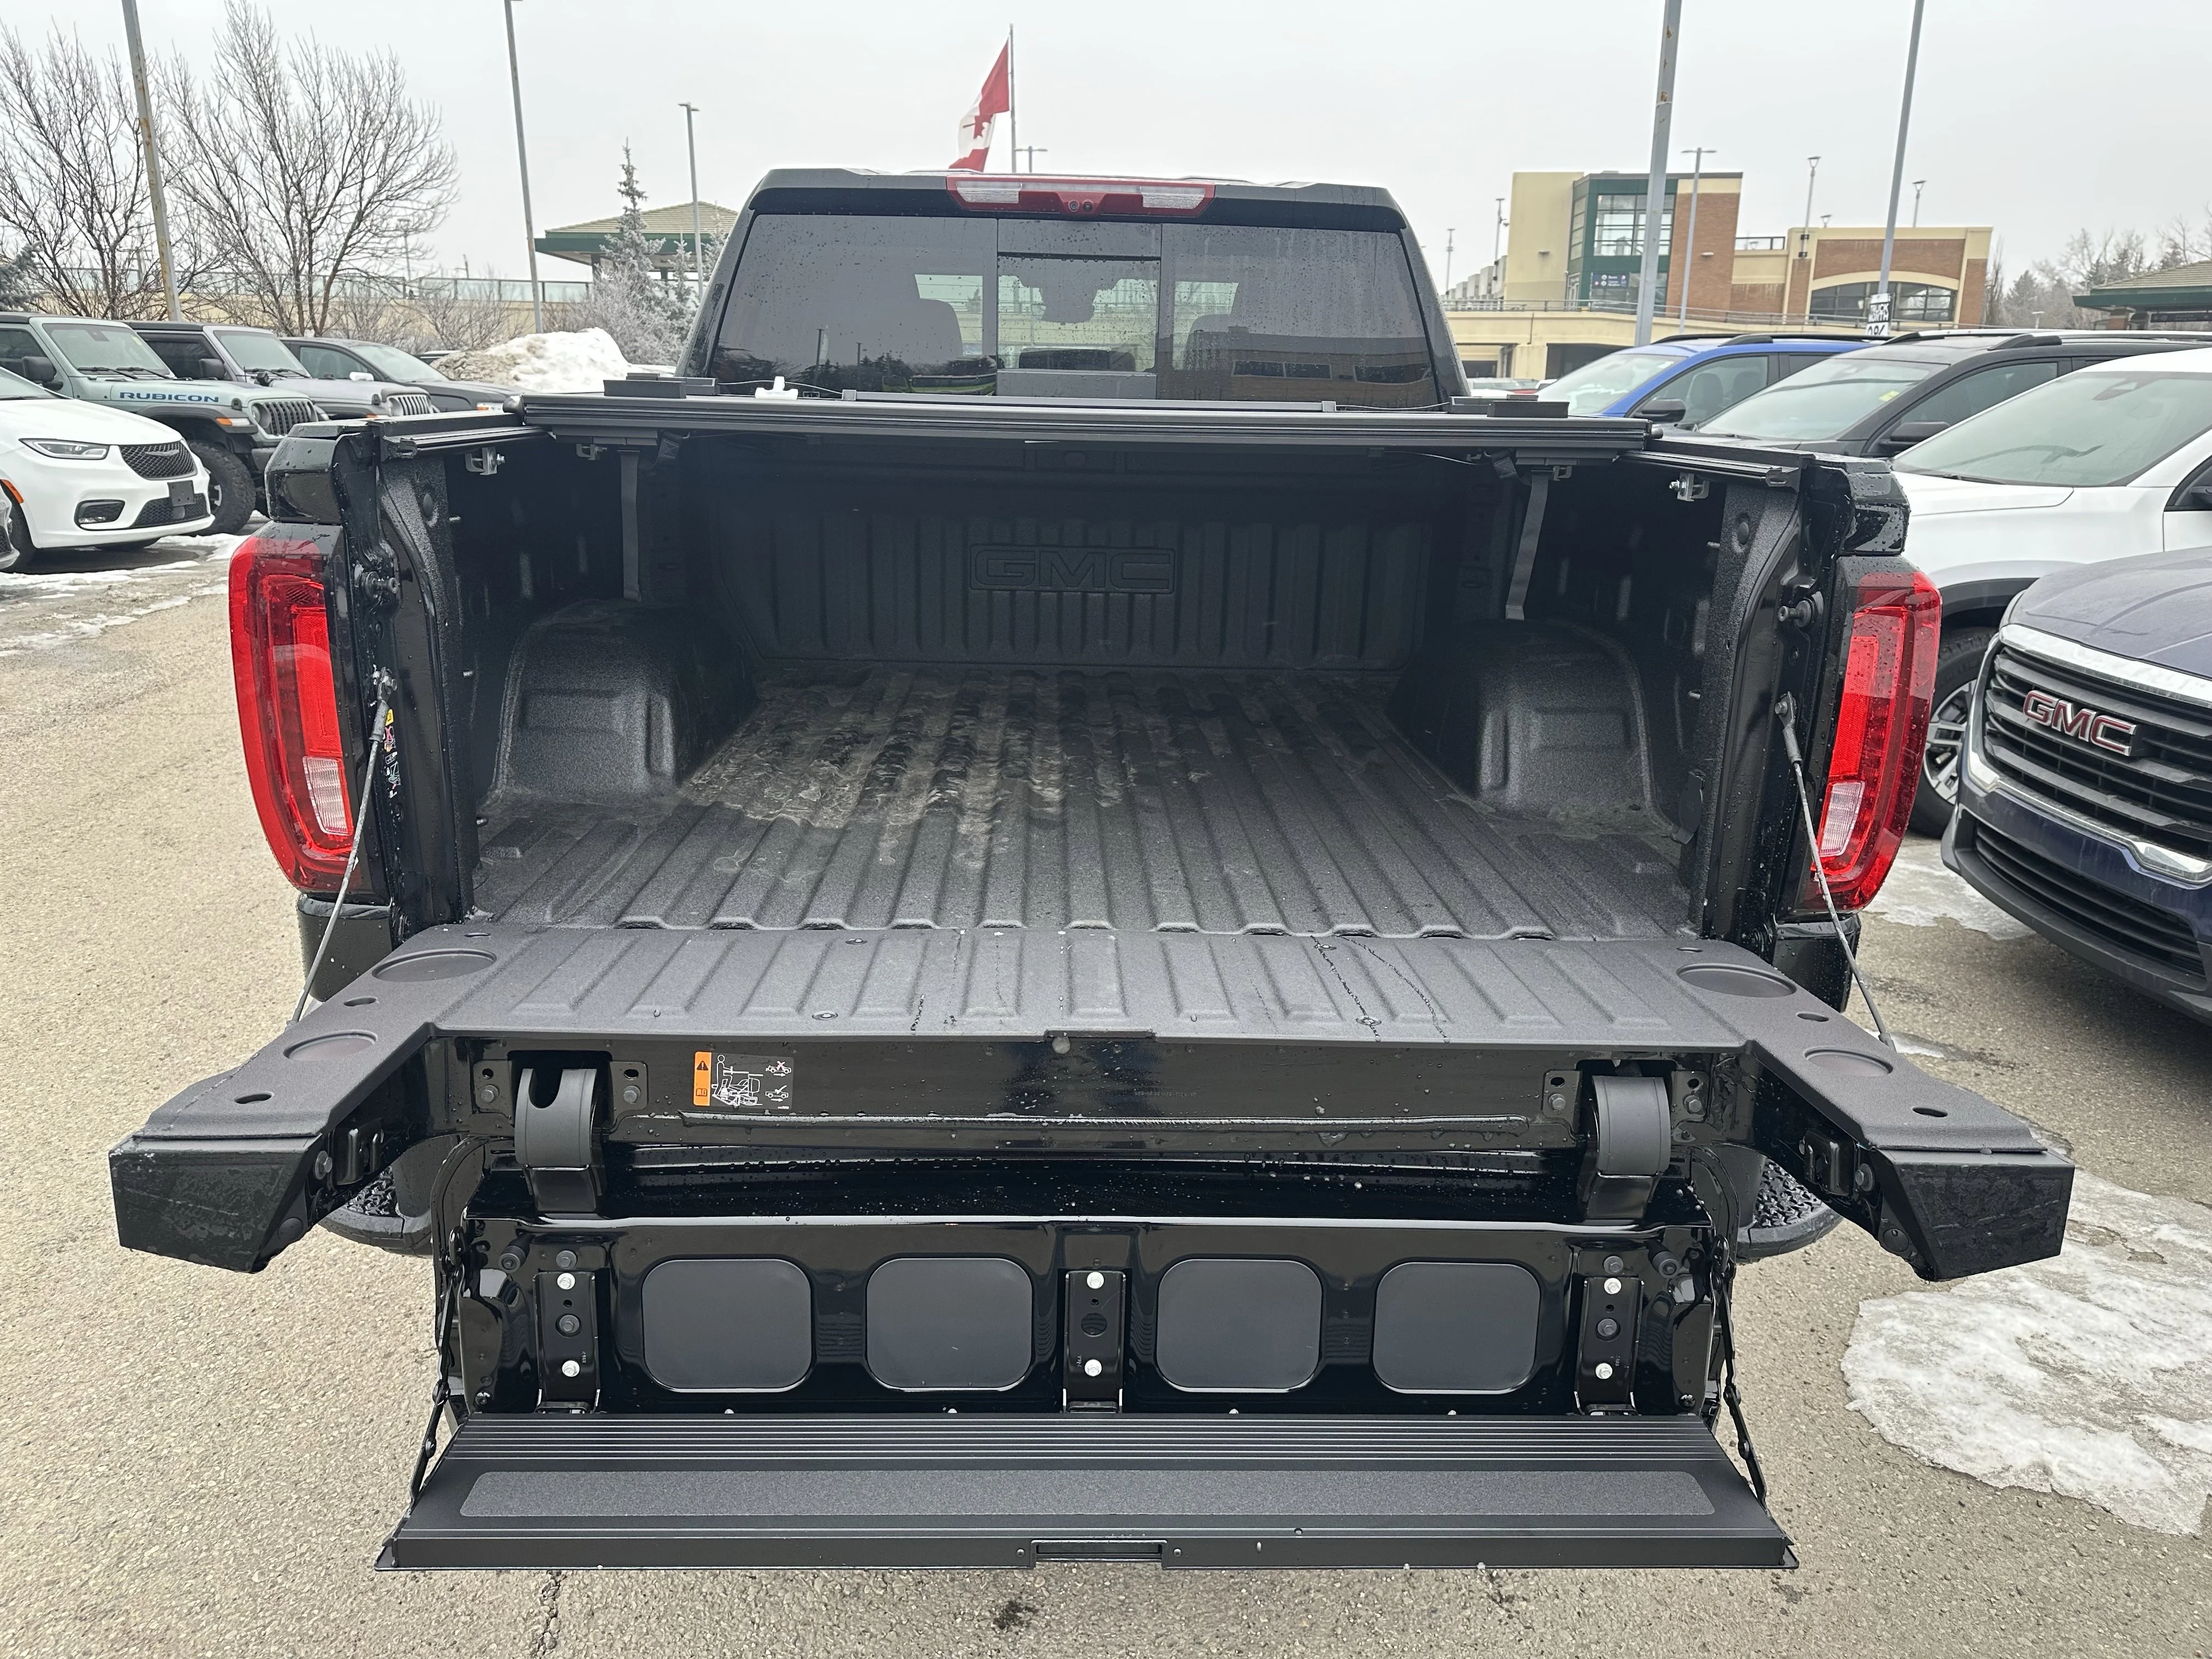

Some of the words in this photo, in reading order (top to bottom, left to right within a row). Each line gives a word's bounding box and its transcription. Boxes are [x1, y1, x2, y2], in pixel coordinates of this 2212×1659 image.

[120, 392, 219, 403] RUBICON
[975, 549, 1171, 590] GMC
[2022, 689, 2138, 757] GMC
